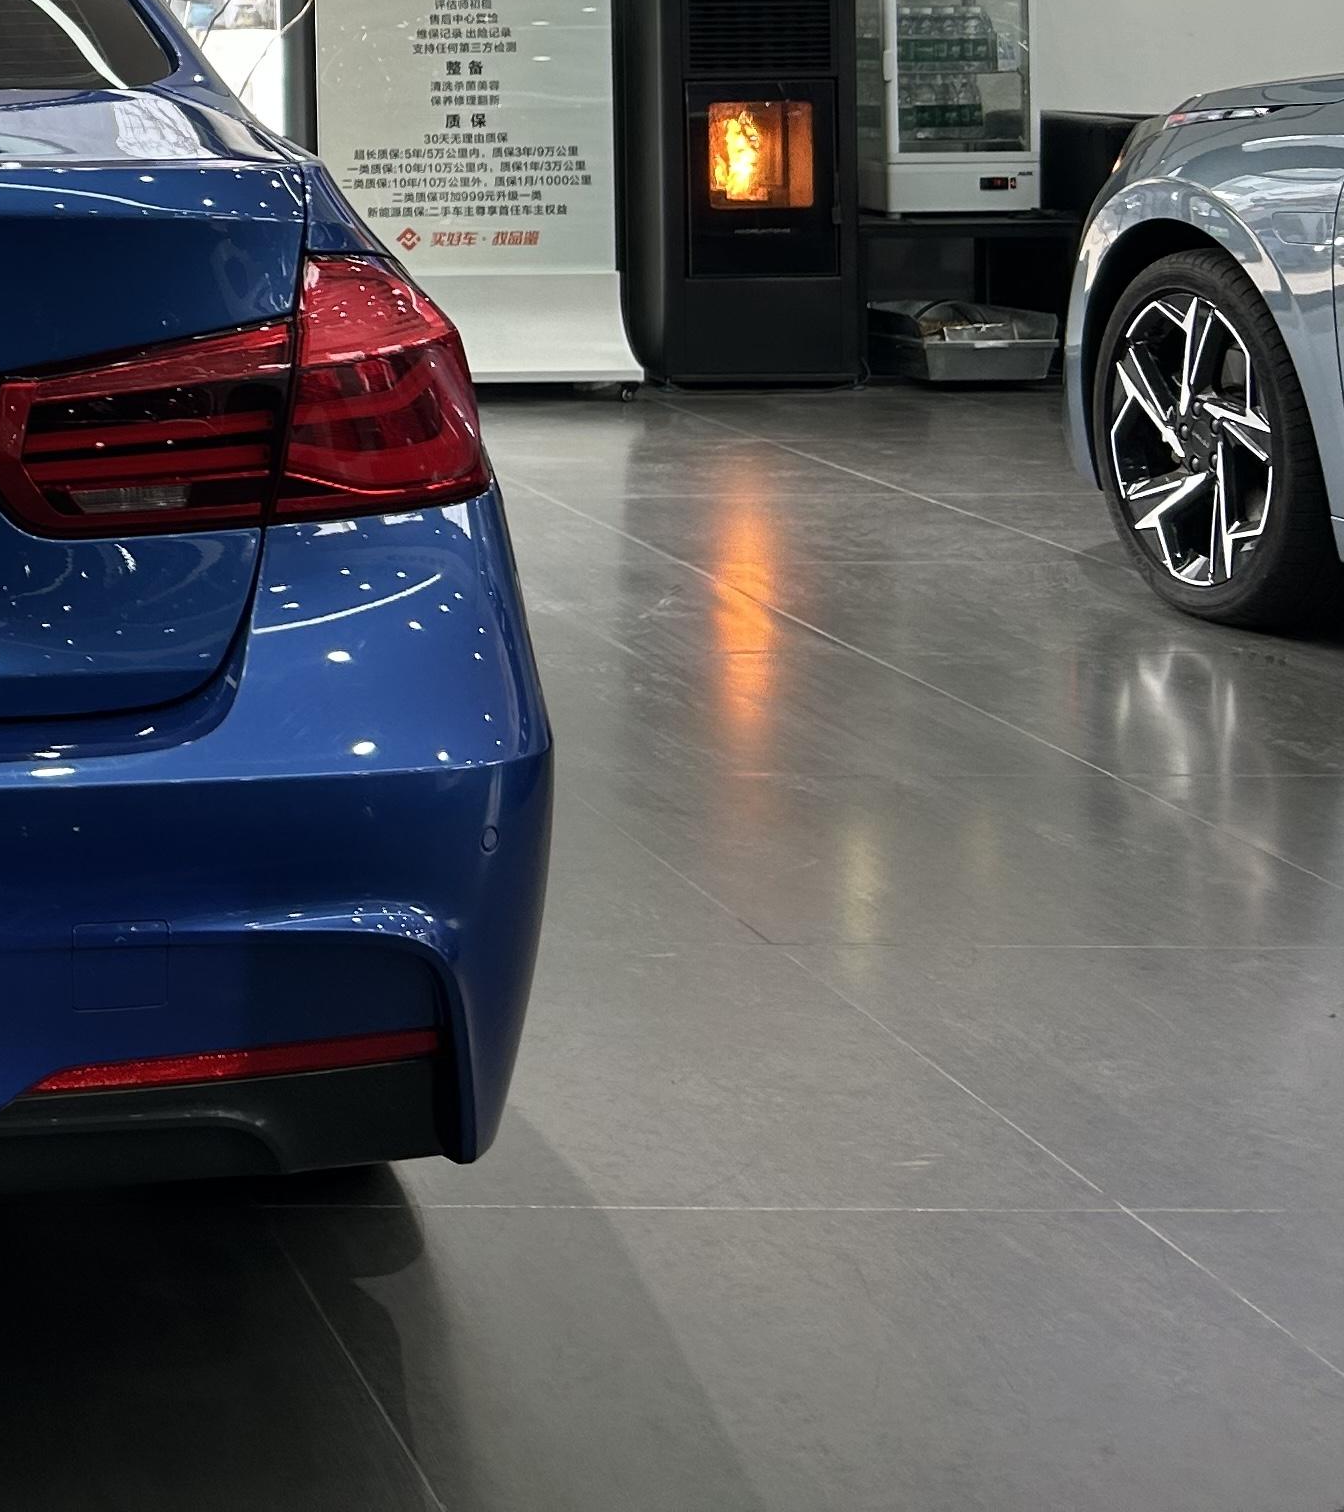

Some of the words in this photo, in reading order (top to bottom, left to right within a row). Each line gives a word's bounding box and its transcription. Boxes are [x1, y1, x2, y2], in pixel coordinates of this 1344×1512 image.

[412, 41, 517, 55] 支持任何第三方检测
[423, 132, 508, 145] 30天无理由质保
